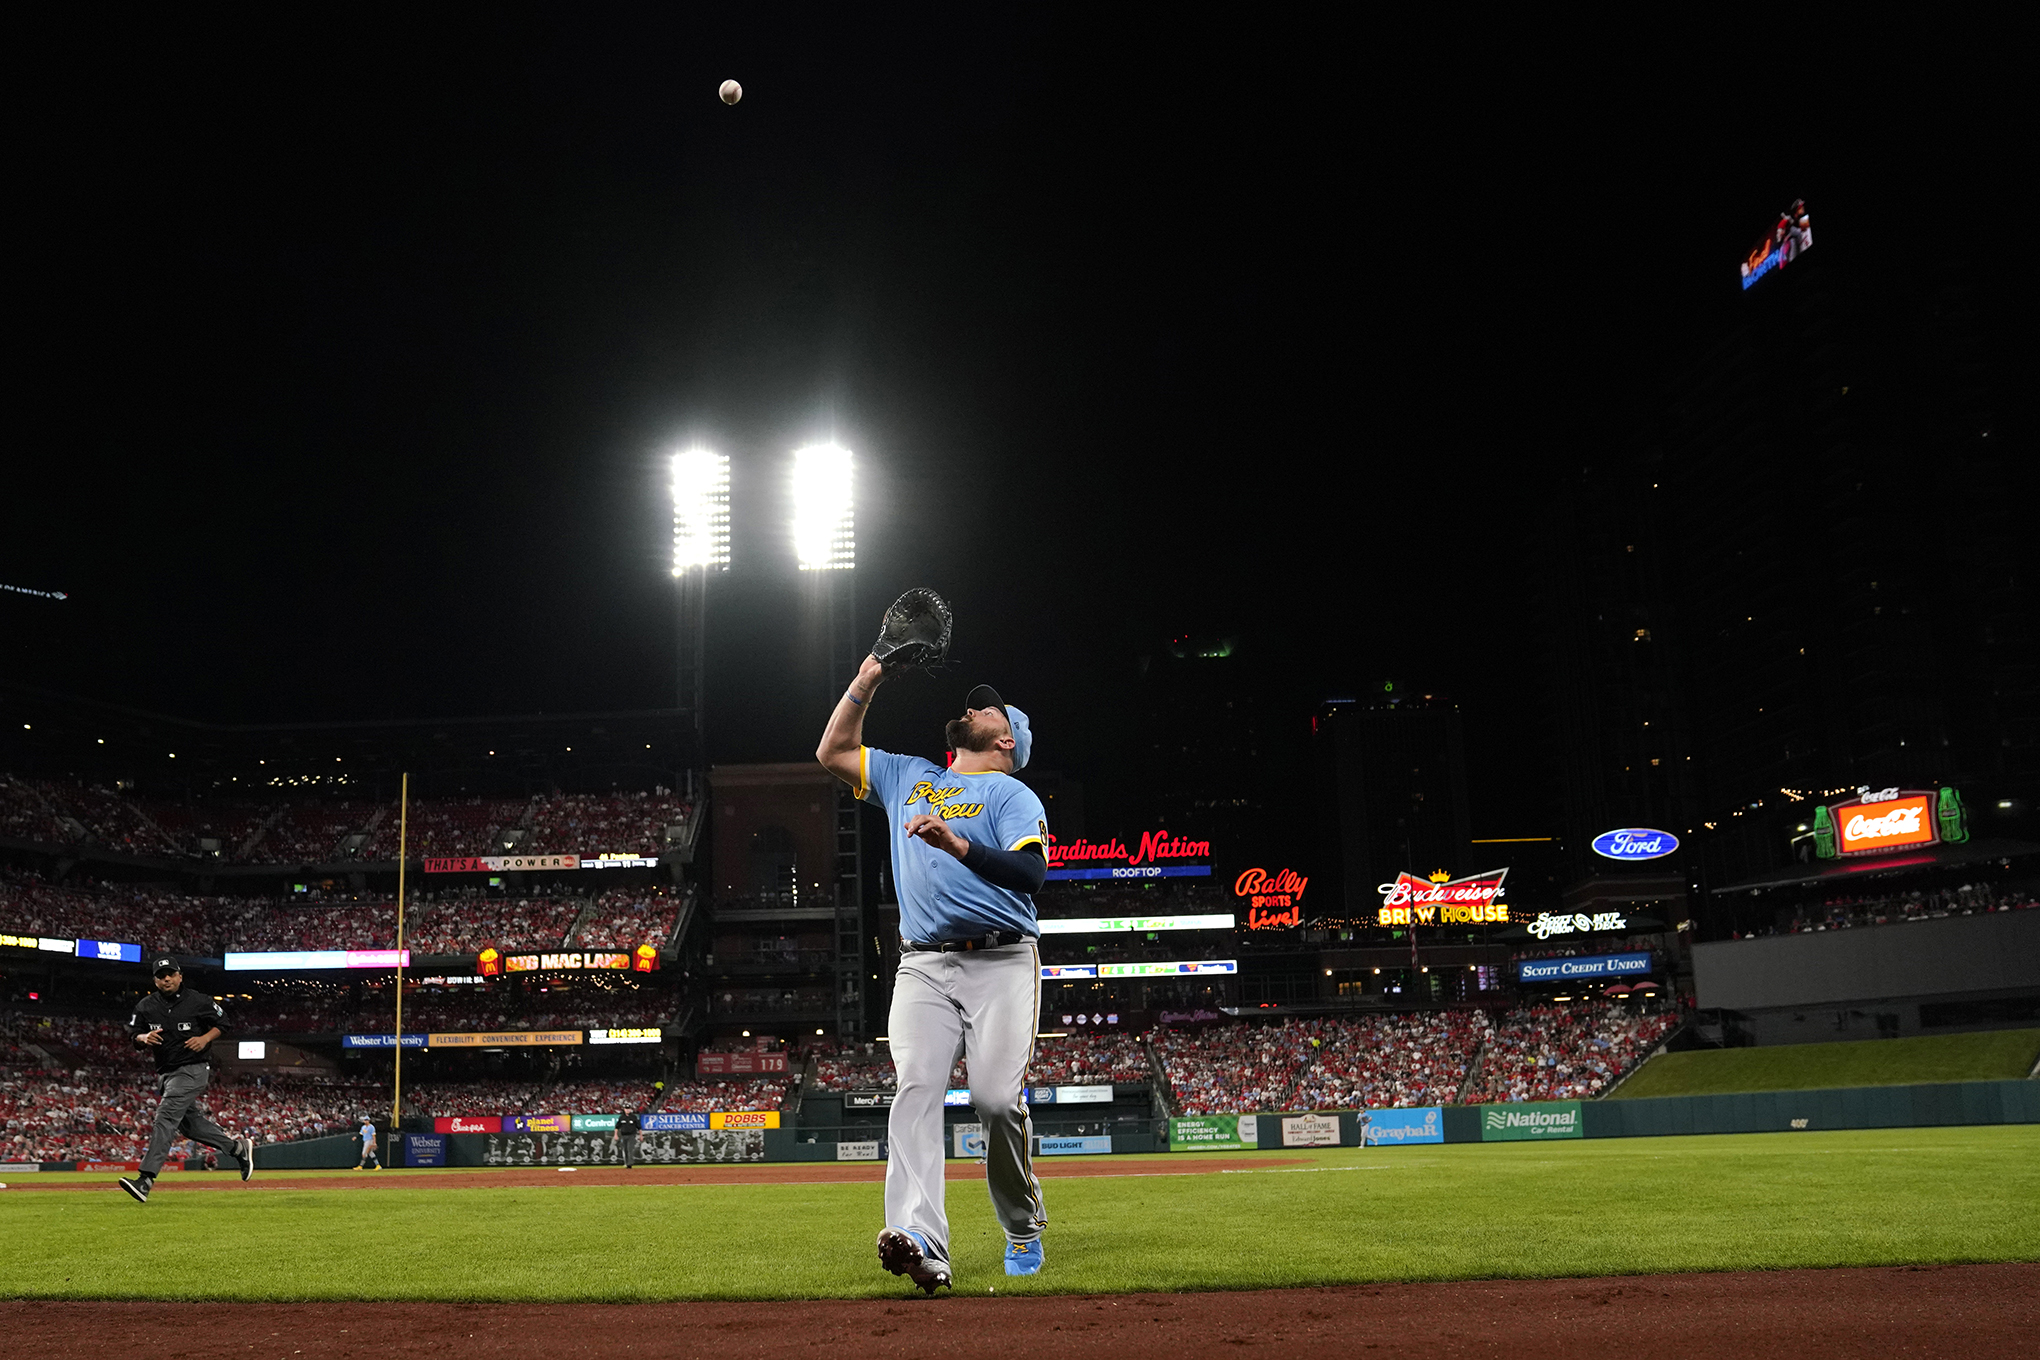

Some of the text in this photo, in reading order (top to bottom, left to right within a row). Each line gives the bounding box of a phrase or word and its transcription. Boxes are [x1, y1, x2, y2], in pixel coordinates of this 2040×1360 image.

[905, 781, 966, 805] Brew
[1861, 787, 1899, 804] Coca-Cola
[930, 800, 985, 821] Crew
[1845, 806, 1923, 841] Coca-Cola
[1129, 830, 1210, 865] Nation
[1610, 831, 1661, 855] Ford
[427, 857, 560, 872] THAT'S A POWER
[1112, 867, 1162, 878] ROOFTOP
[1235, 868, 1309, 900] Bally
[1378, 883, 1505, 905] Budweiser
[1251, 895, 1291, 908] SPORTS
[1249, 906, 1300, 930] Live!
[1379, 904, 1509, 925] BREW HOUSE
[1593, 912, 1620, 922] MVP
[1593, 920, 1626, 931] DECK
[506, 953, 630, 972] BIG MAC LAND
[350, 1036, 381, 1046] Webster
[436, 1034, 576, 1044] FLEXIBILITY CONVENIENCE EXPERIENCE
[761, 1059, 783, 1070] 179
[854, 1097, 875, 1106] Mercy
[527, 1117, 554, 1127] planet
[585, 1118, 615, 1127] Central
[658, 1114, 706, 1123] SITEMAN
[724, 1114, 766, 1123] DOBBS
[1506, 1110, 1576, 1127] National
[1177, 1127, 1219, 1135] EFFICIENCY
[410, 1137, 441, 1147] Webster
